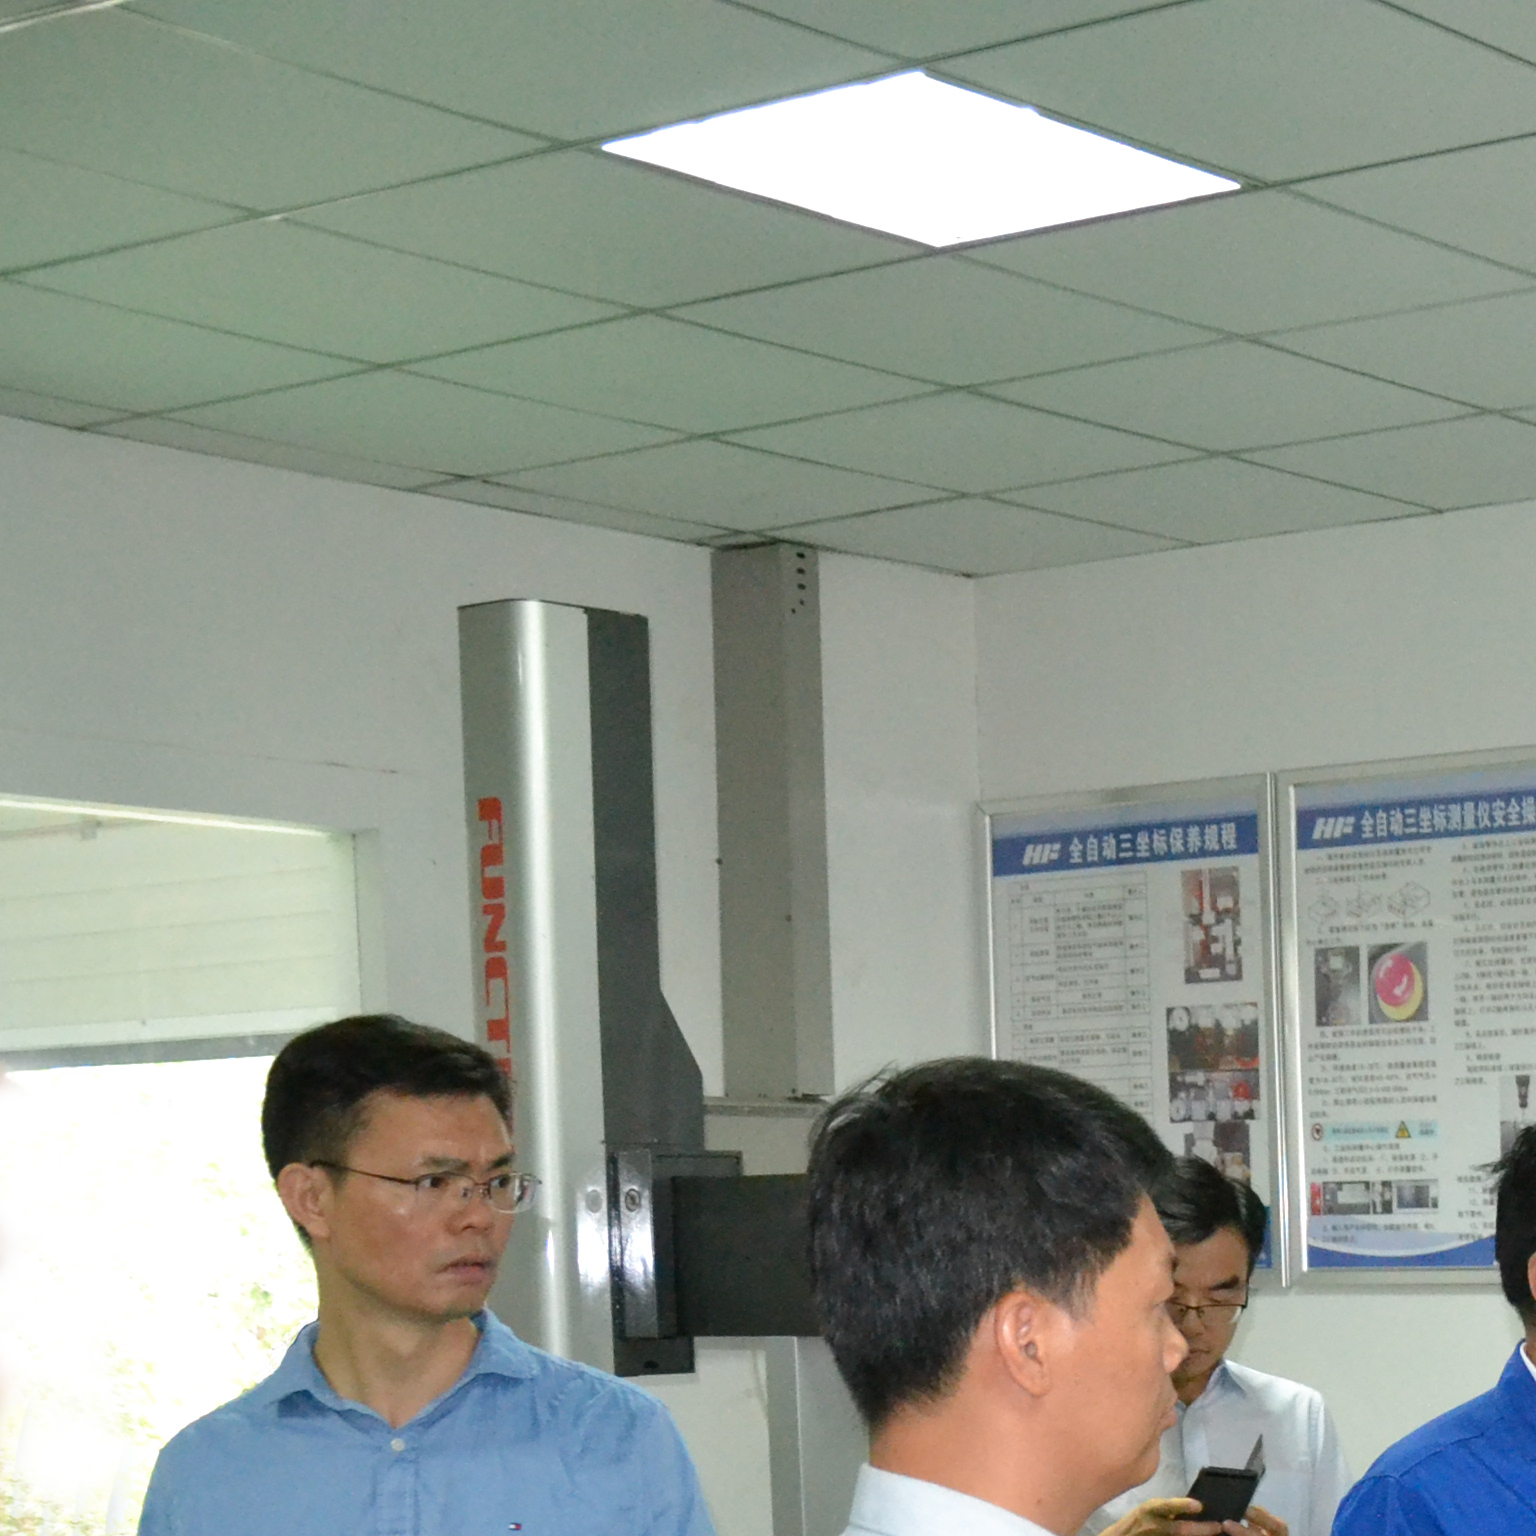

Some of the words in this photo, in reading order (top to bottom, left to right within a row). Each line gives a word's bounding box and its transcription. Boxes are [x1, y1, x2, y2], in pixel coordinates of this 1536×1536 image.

[1069, 822, 1238, 864] 全自动三坐标保养规程
